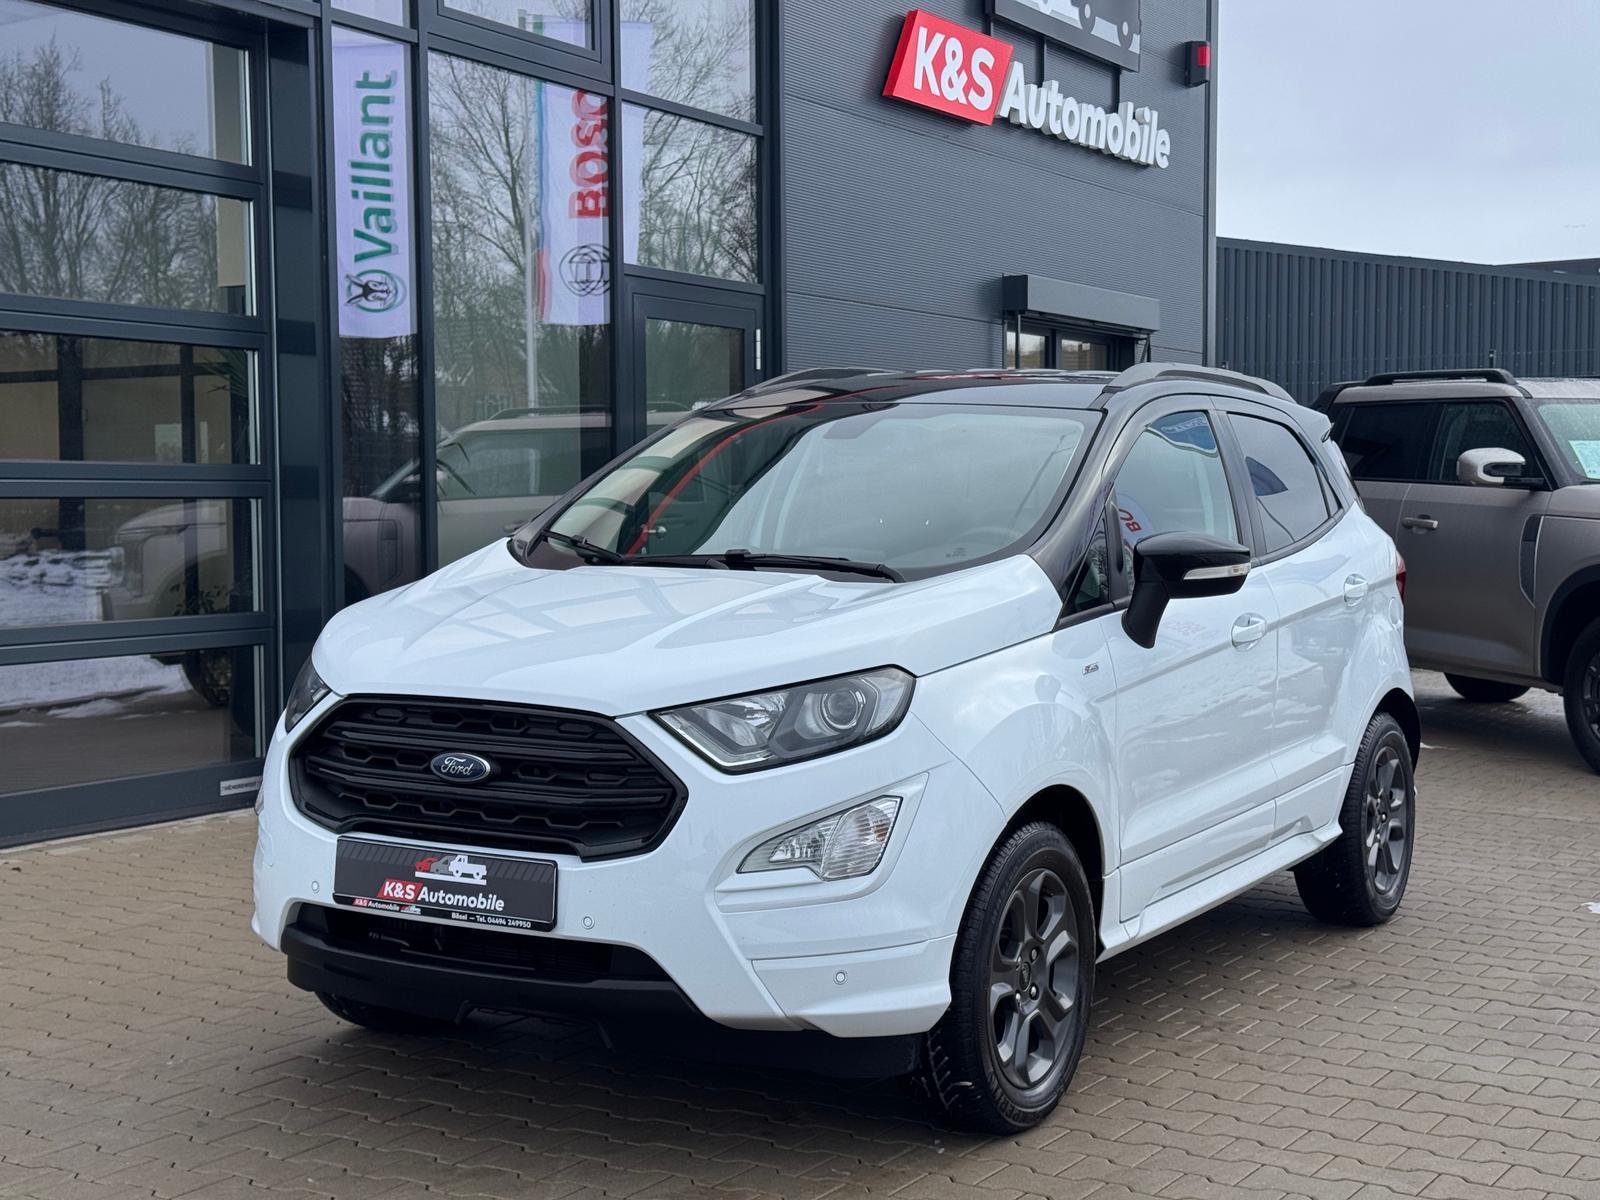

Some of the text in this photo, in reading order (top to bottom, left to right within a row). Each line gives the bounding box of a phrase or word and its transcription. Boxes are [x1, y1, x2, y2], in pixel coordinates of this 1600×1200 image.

[913, 26, 1171, 169] K&S Automobile
[350, 69, 398, 264] Vaillant
[441, 756, 474, 775] Ford
[353, 898, 400, 912] K&S Automobile
[383, 881, 505, 912] K&S Automobile
[507, 919, 532, 929] 249950
